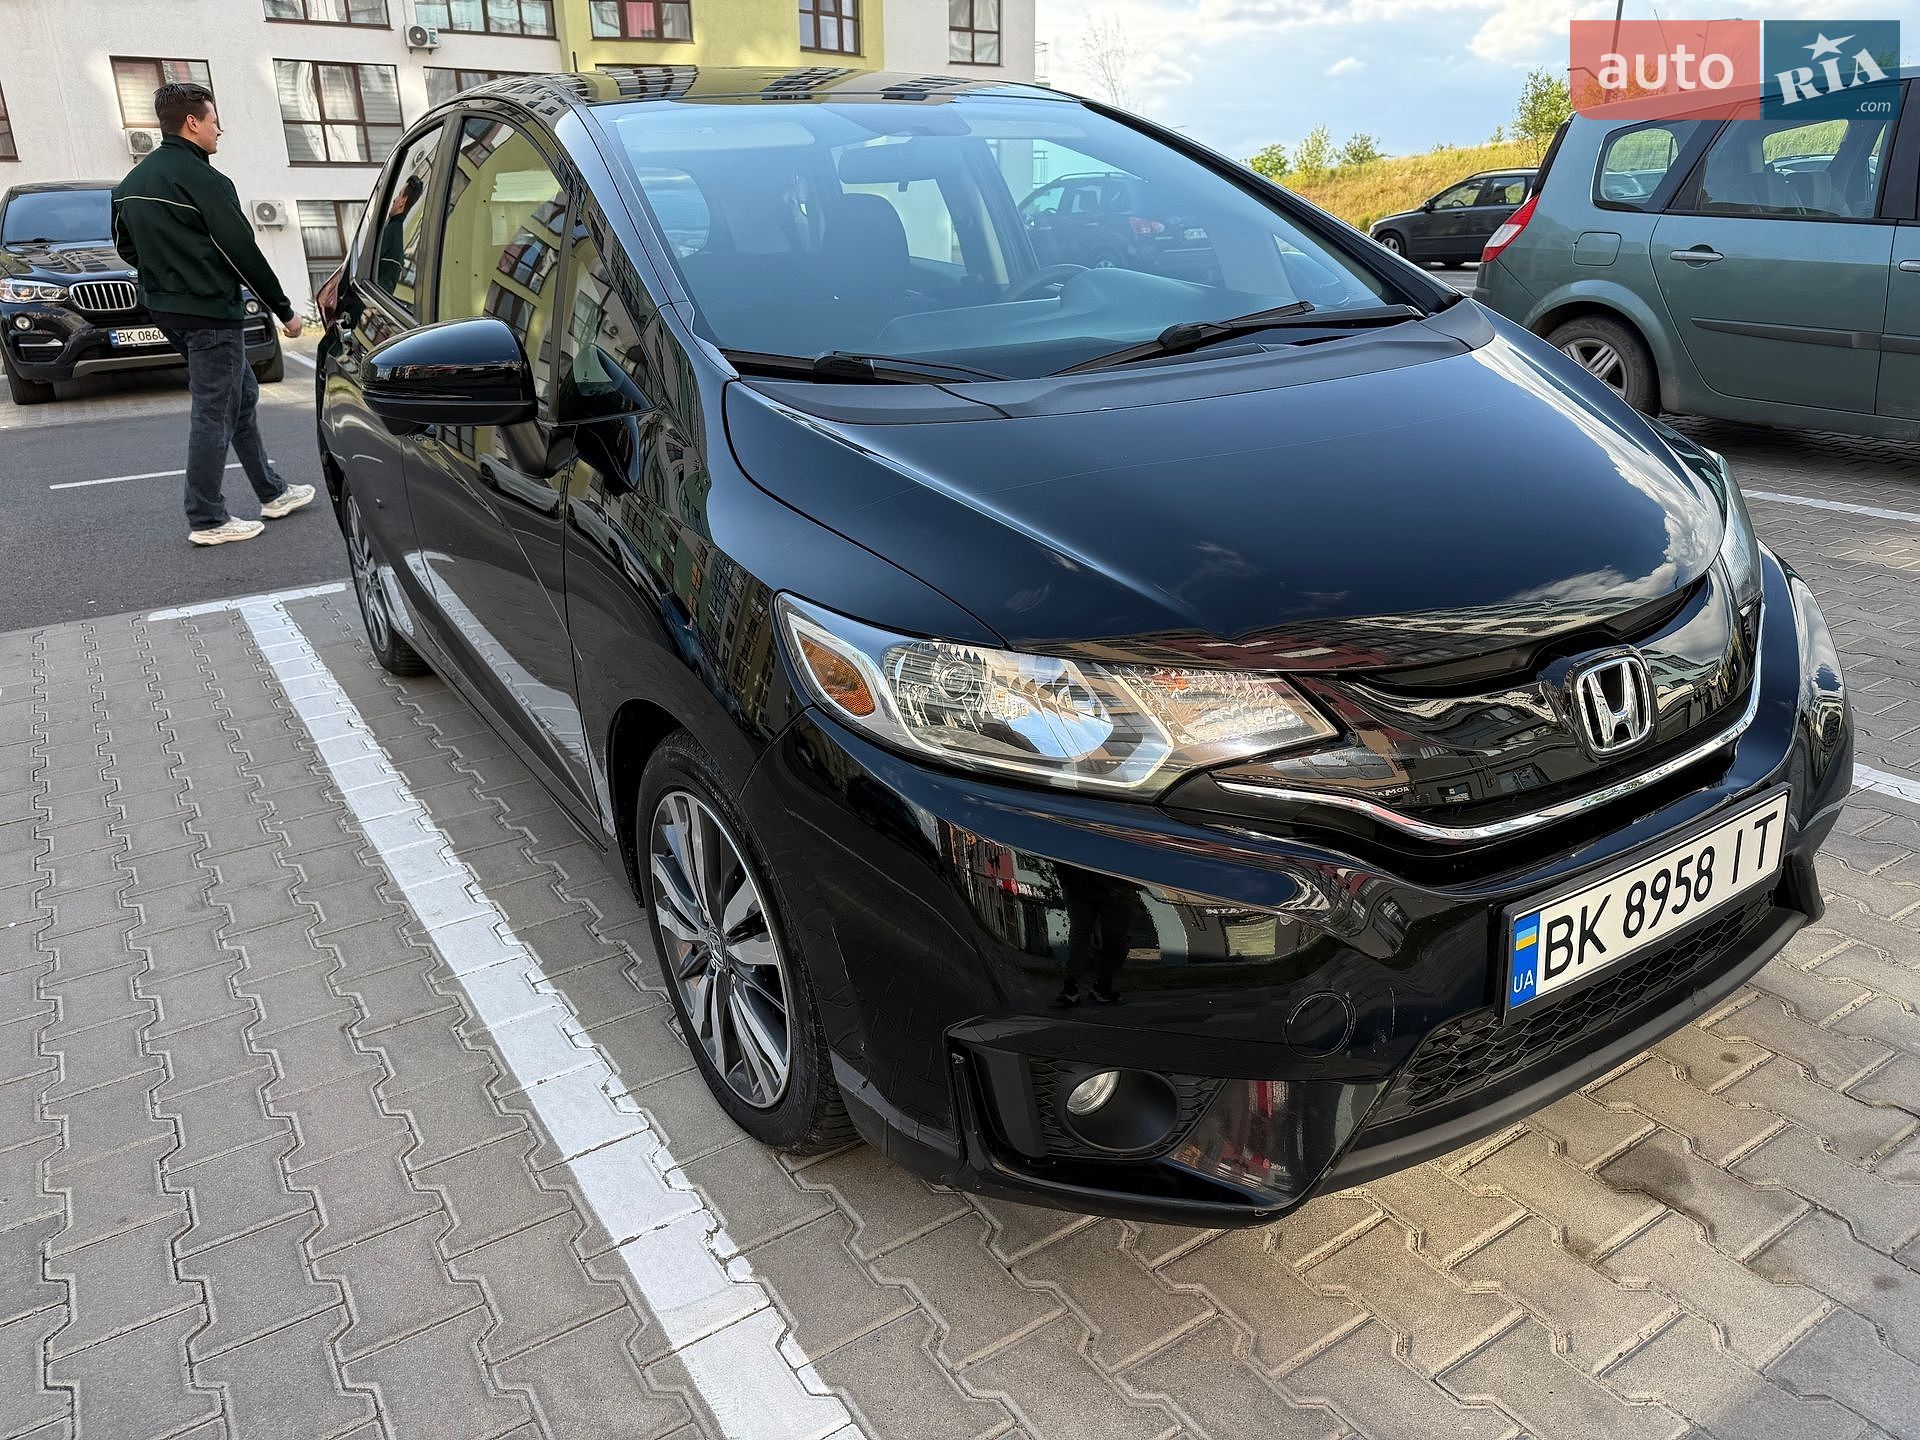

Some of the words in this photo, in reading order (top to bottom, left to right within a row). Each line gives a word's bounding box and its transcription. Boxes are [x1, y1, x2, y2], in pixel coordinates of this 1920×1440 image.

[118, 332, 135, 342] BK
[1543, 893, 1612, 982] BK
[1622, 845, 1716, 939] 8958
[1731, 810, 1778, 885] IT
[1513, 968, 1535, 994] UA
